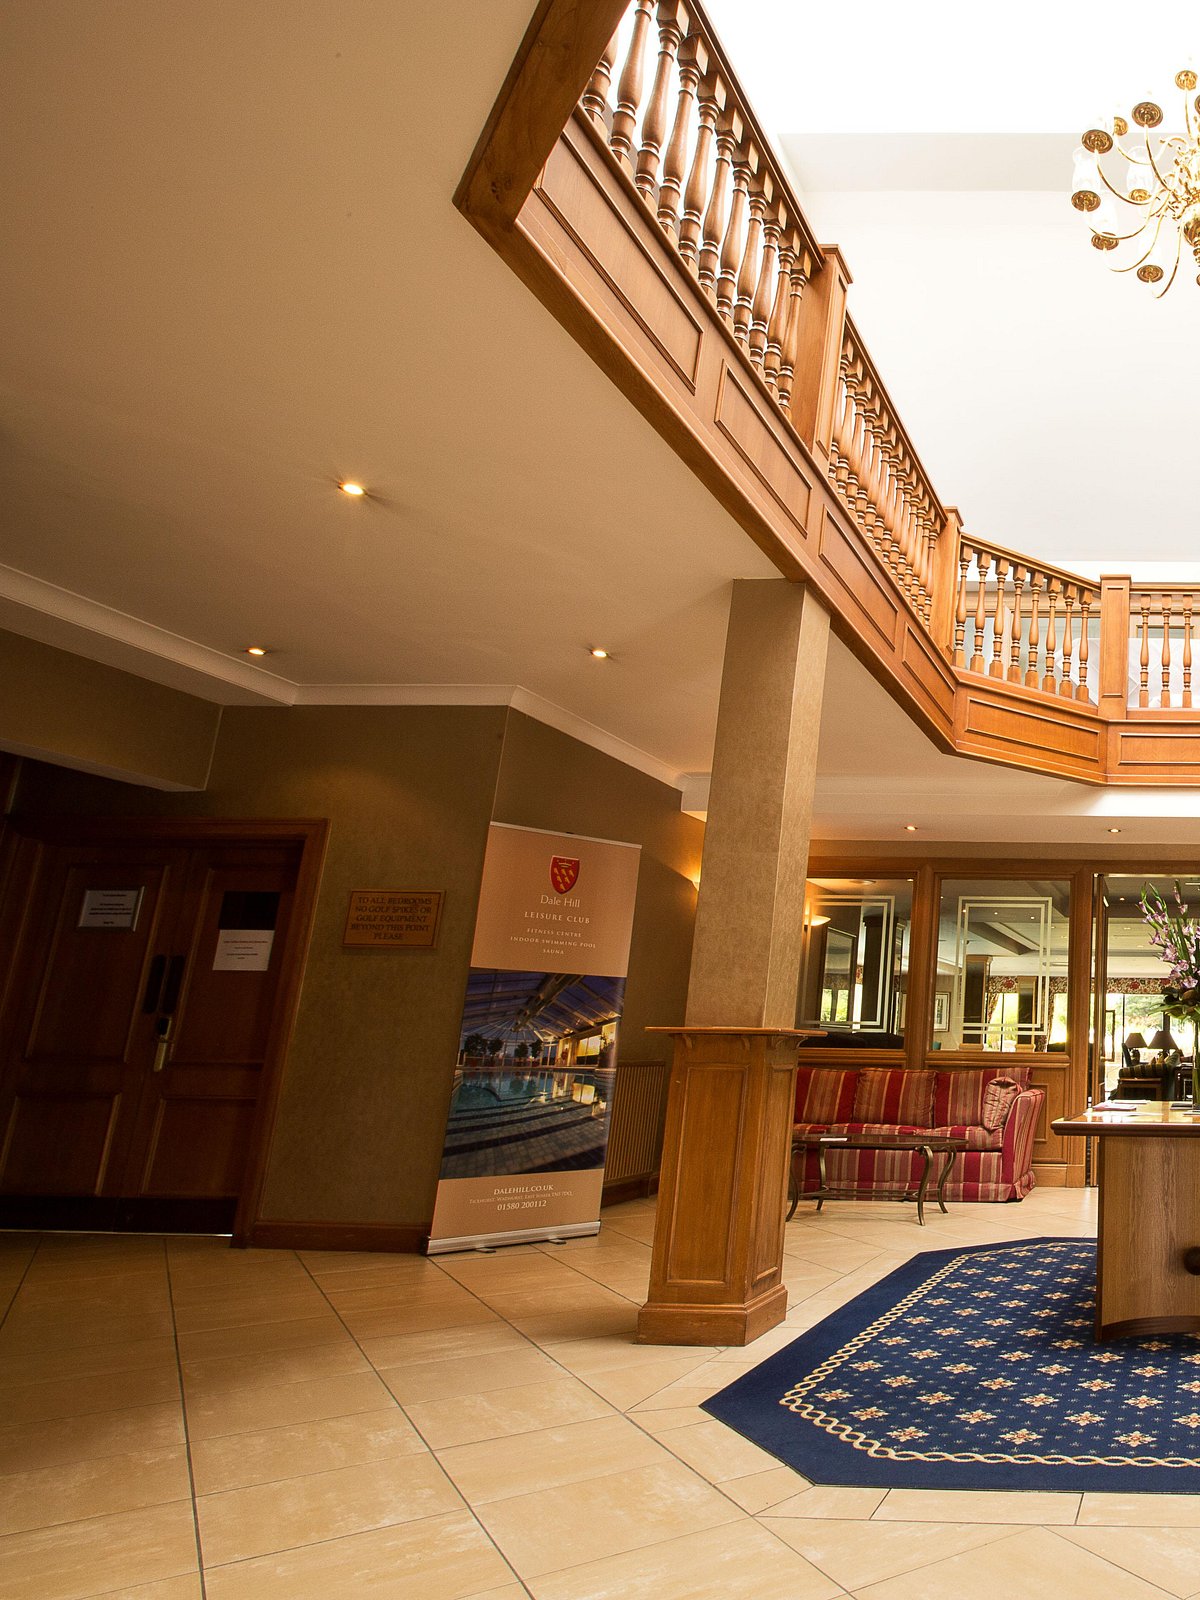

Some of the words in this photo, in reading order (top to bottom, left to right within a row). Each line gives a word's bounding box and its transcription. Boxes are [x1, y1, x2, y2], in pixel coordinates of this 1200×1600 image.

[540, 894, 561, 906] Dale
[563, 897, 581, 908] Hill
[524, 911, 563, 921] LEISURE
[566, 915, 590, 924] CLUB
[556, 930, 582, 938] CENTRE
[510, 935, 540, 943] INDOOR
[541, 939, 578, 947] SWIMMING
[494, 1184, 554, 1195] DALEHILL.CO.UK
[497, 1203, 520, 1211] 01580
[521, 1200, 547, 1210] 200112
